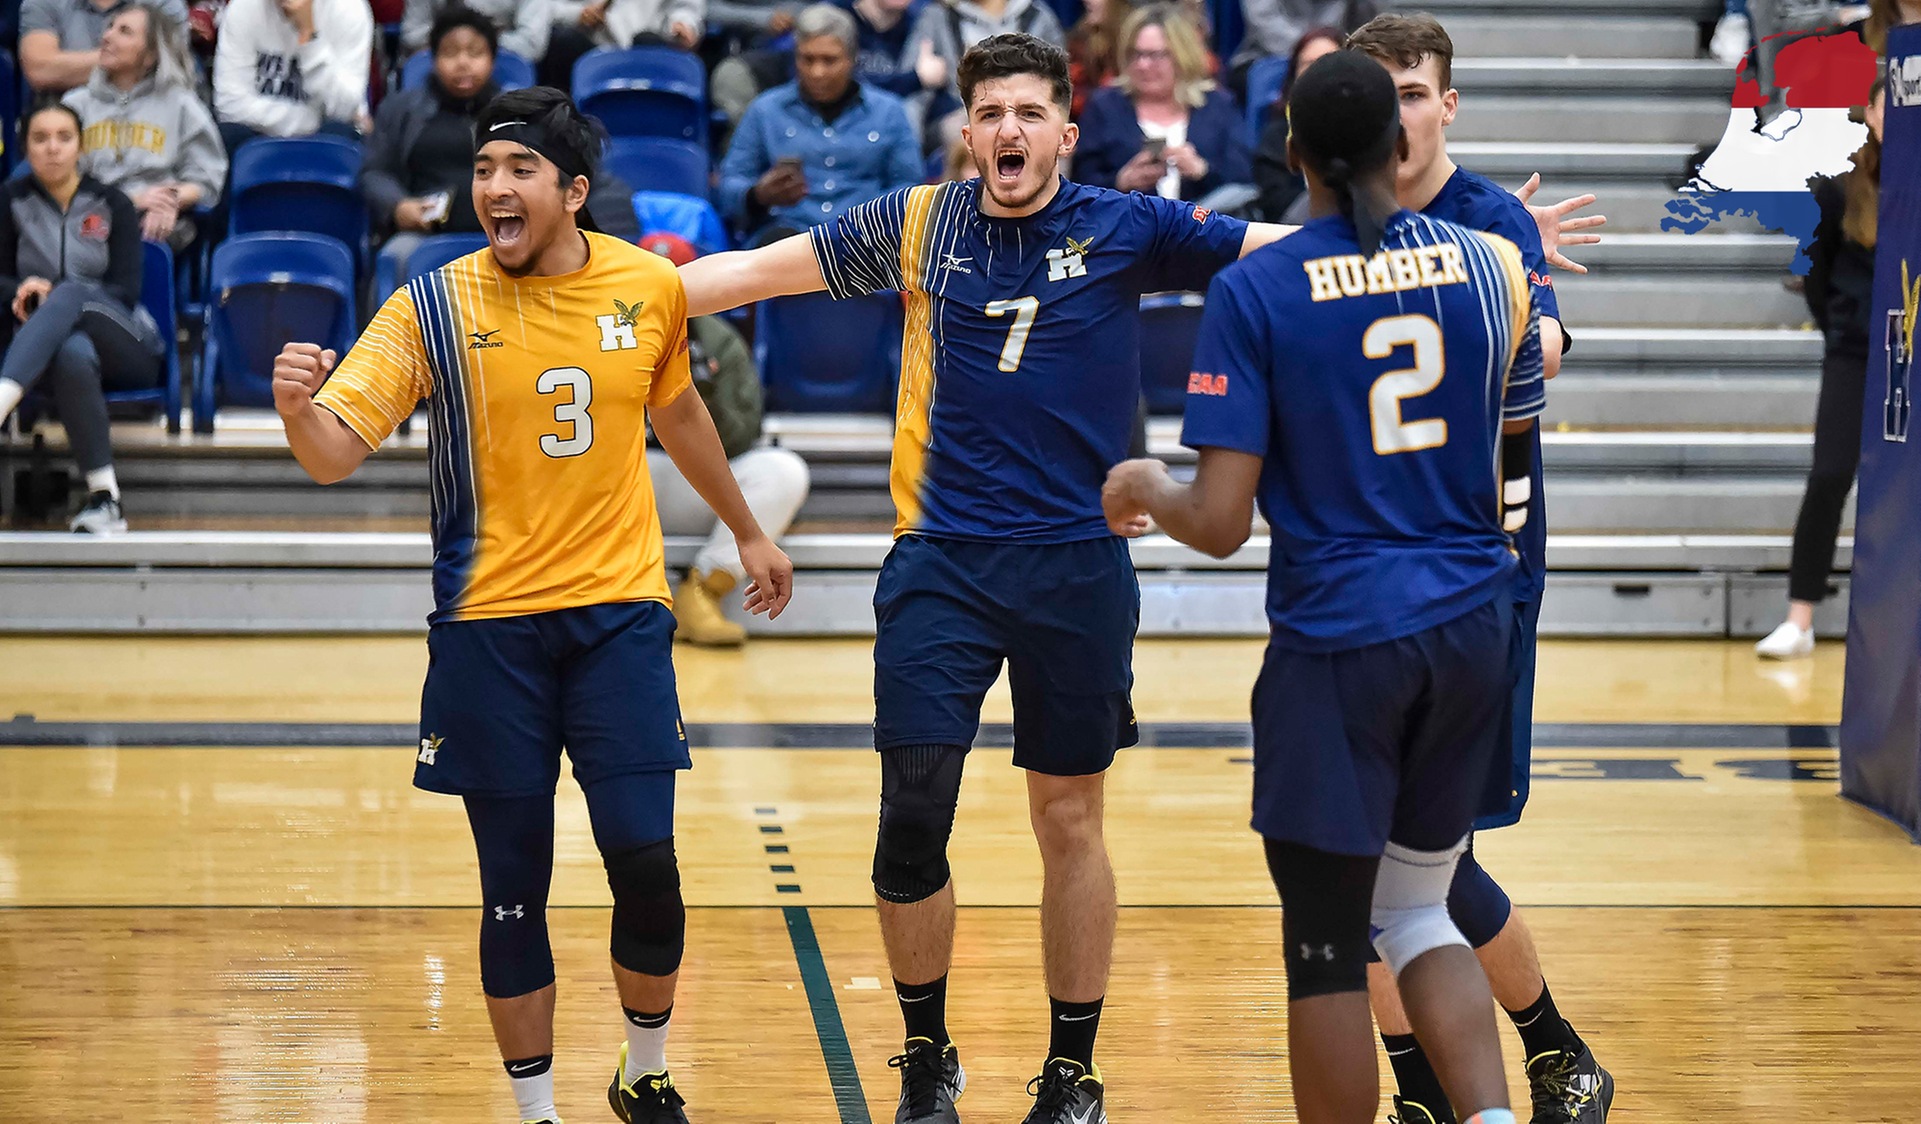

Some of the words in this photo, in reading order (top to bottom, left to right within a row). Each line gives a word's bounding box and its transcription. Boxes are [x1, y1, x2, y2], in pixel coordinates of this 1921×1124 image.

[1303, 242, 1469, 302] HUMBER
[984, 295, 1040, 373] 7
[536, 366, 593, 459] 3
[1362, 313, 1448, 456] 2
